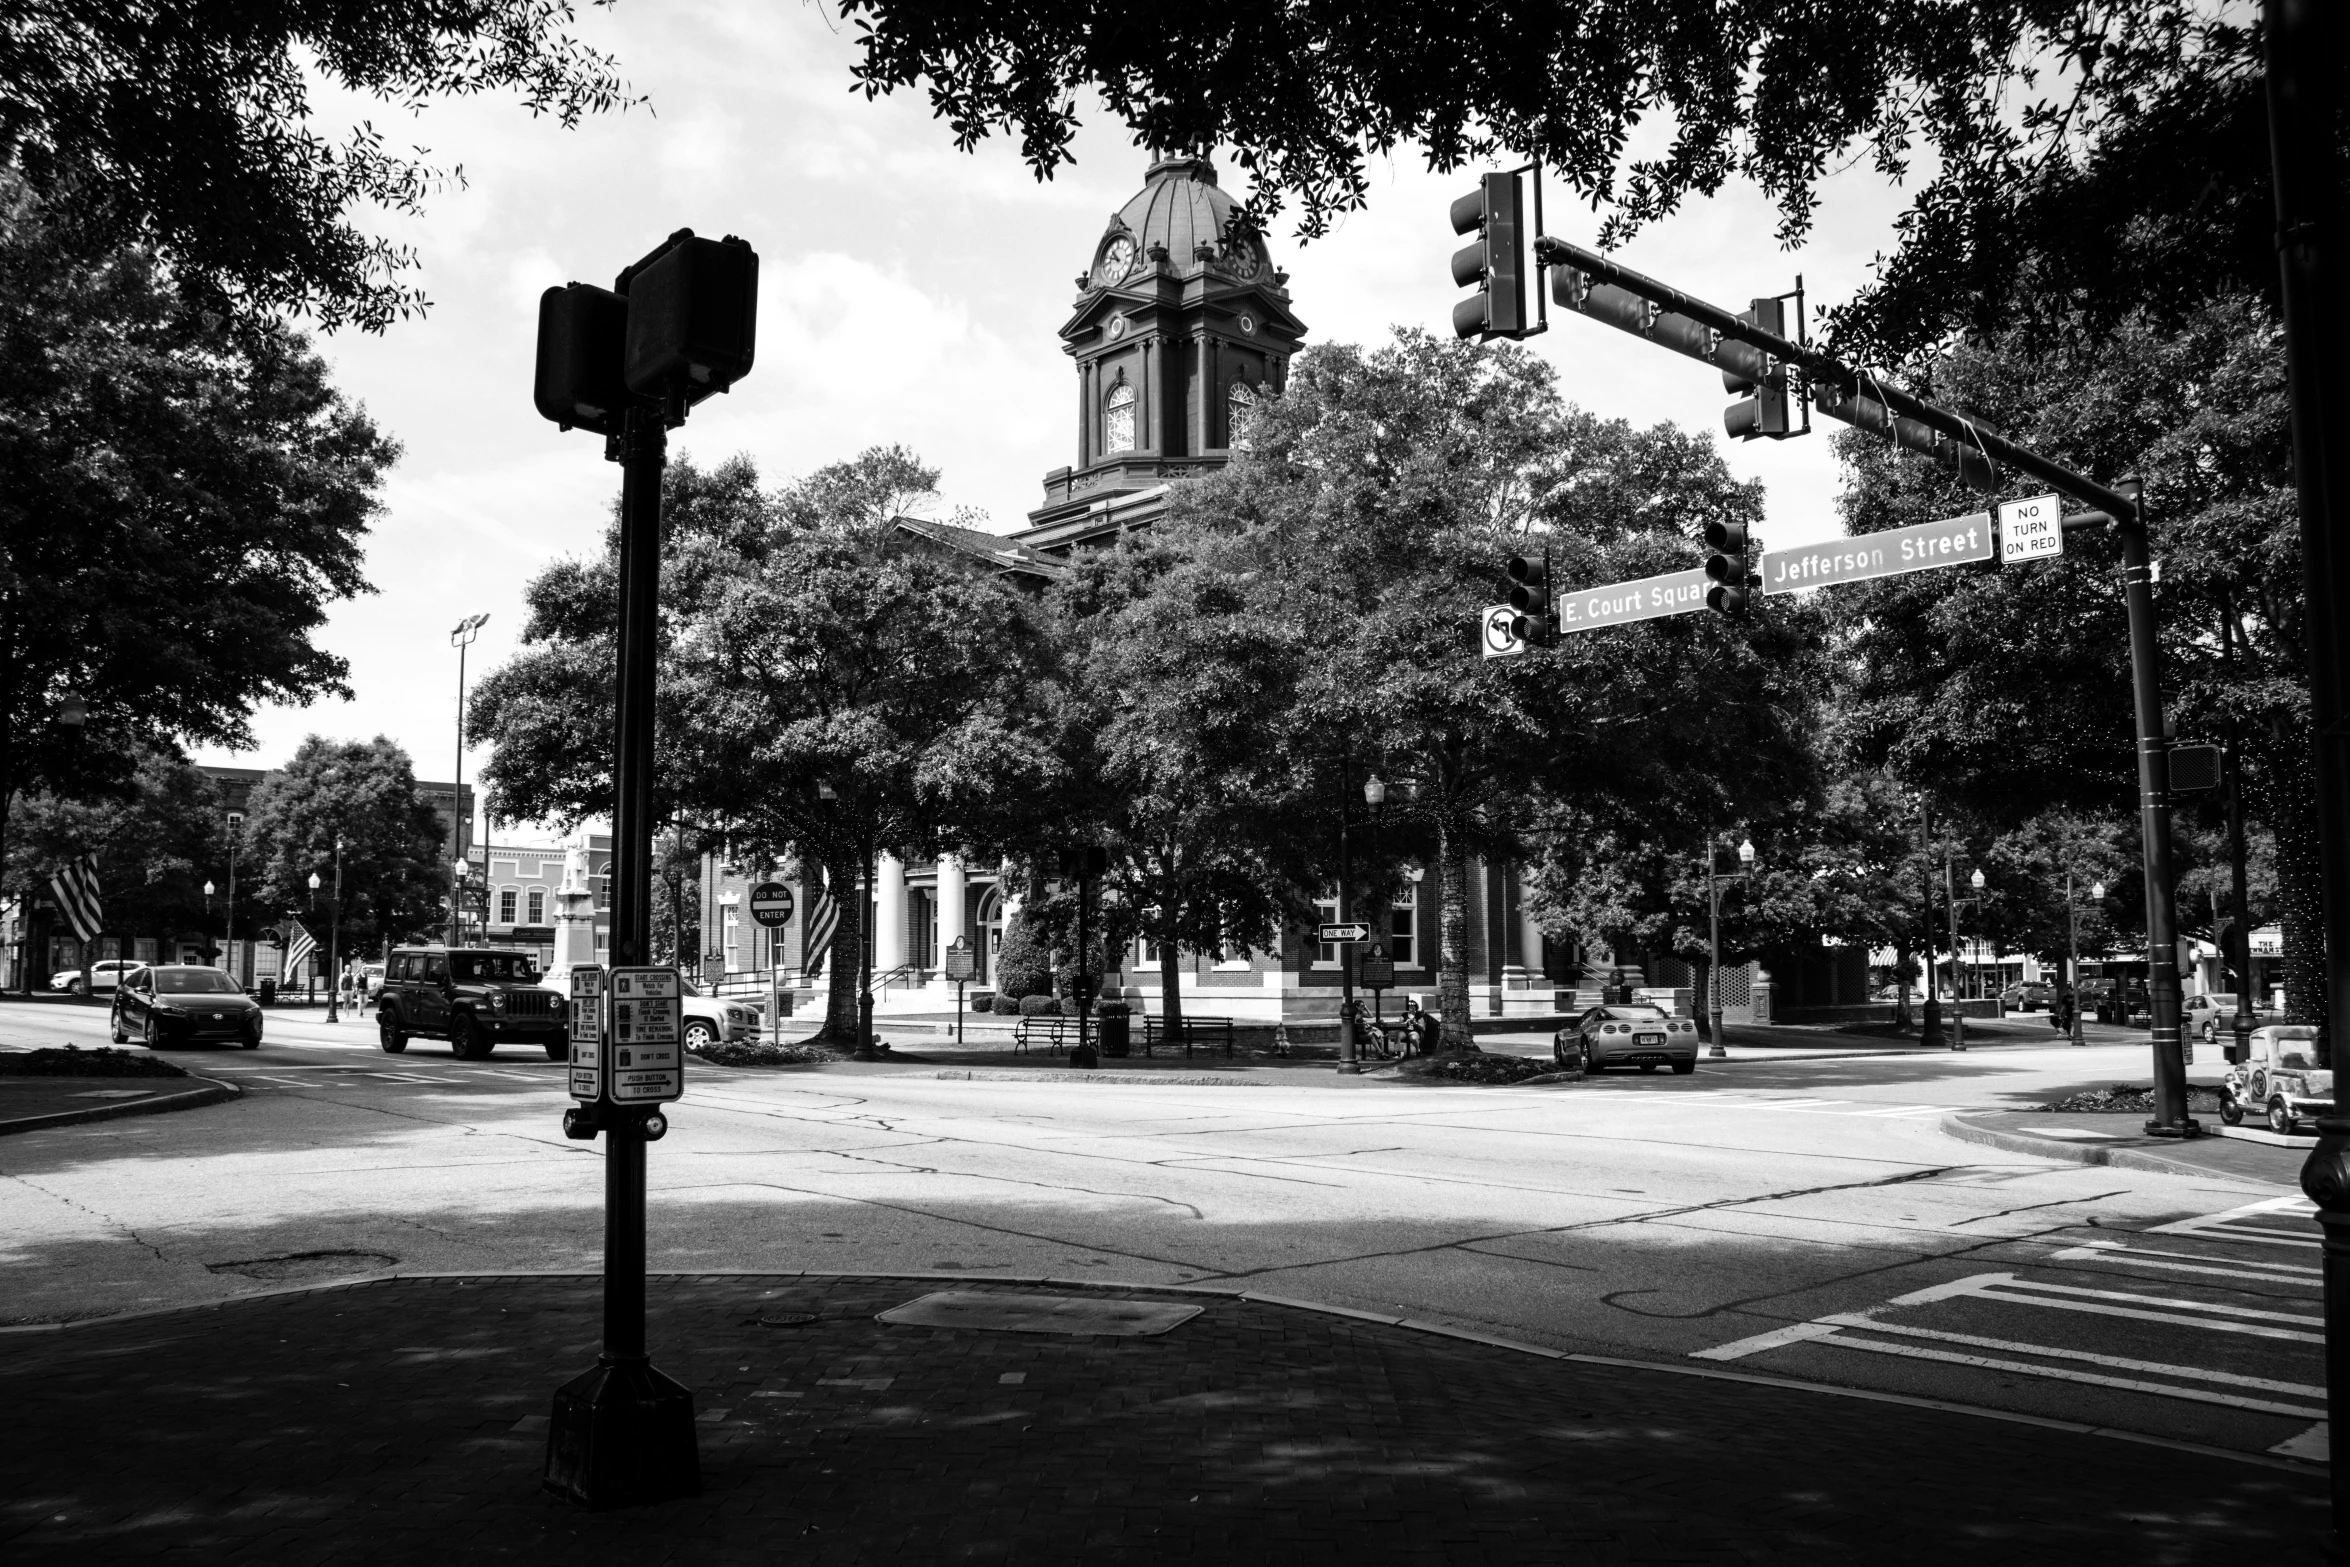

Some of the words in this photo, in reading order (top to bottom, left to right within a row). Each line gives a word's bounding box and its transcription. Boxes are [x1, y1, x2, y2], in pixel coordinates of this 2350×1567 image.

[2018, 506, 2039, 519] NO
[2013, 521, 2047, 536] TURN
[2006, 542, 2024, 554] ON
[2030, 536, 2056, 551] RED
[1774, 548, 1883, 583] Jefferson
[1900, 527, 1978, 561] Street
[1566, 602, 1582, 622] E.
[1587, 591, 1642, 618] Court
[756, 891, 767, 899] DO
[760, 911, 785, 919] ENTER
